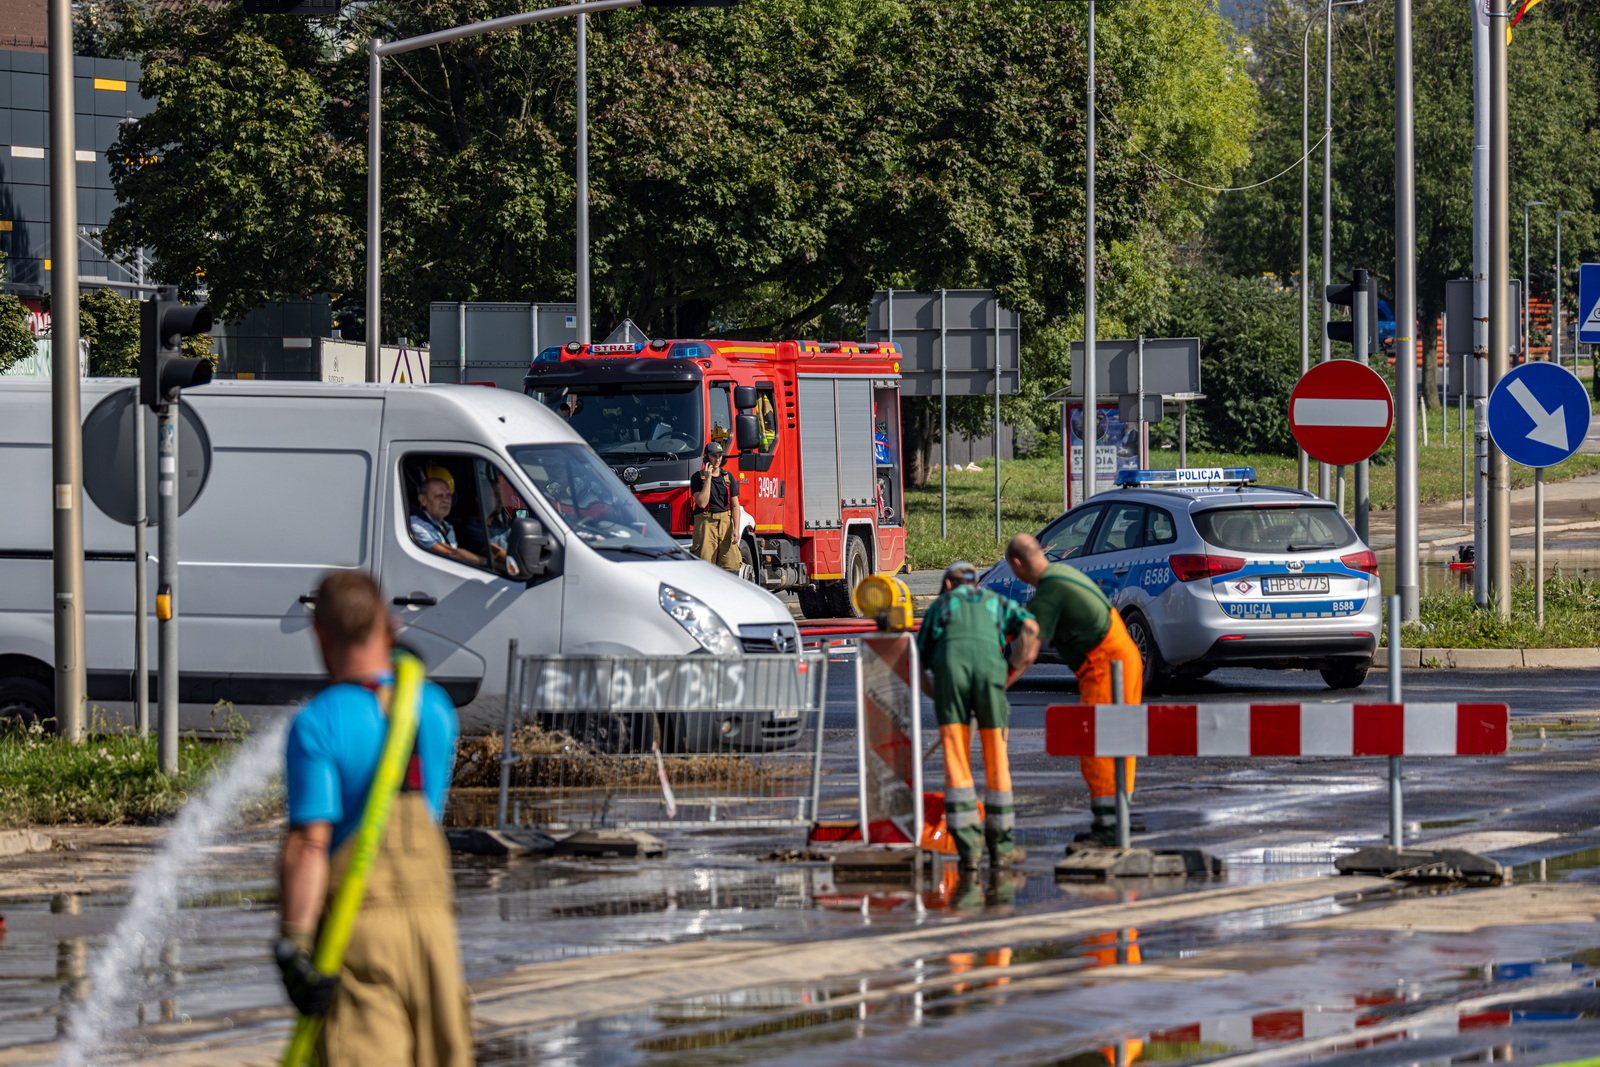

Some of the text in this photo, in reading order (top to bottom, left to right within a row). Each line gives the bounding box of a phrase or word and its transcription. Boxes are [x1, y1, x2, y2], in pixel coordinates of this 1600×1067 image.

[1073, 447, 1115, 456] BEATNE
[1074, 457, 1114, 465] SDIA
[1178, 470, 1221, 480] POLICJA
[1144, 567, 1170, 585] B588
[1269, 576, 1327, 591] HPB C775
[1230, 603, 1272, 615] POLICJA
[1332, 601, 1355, 611] B588
